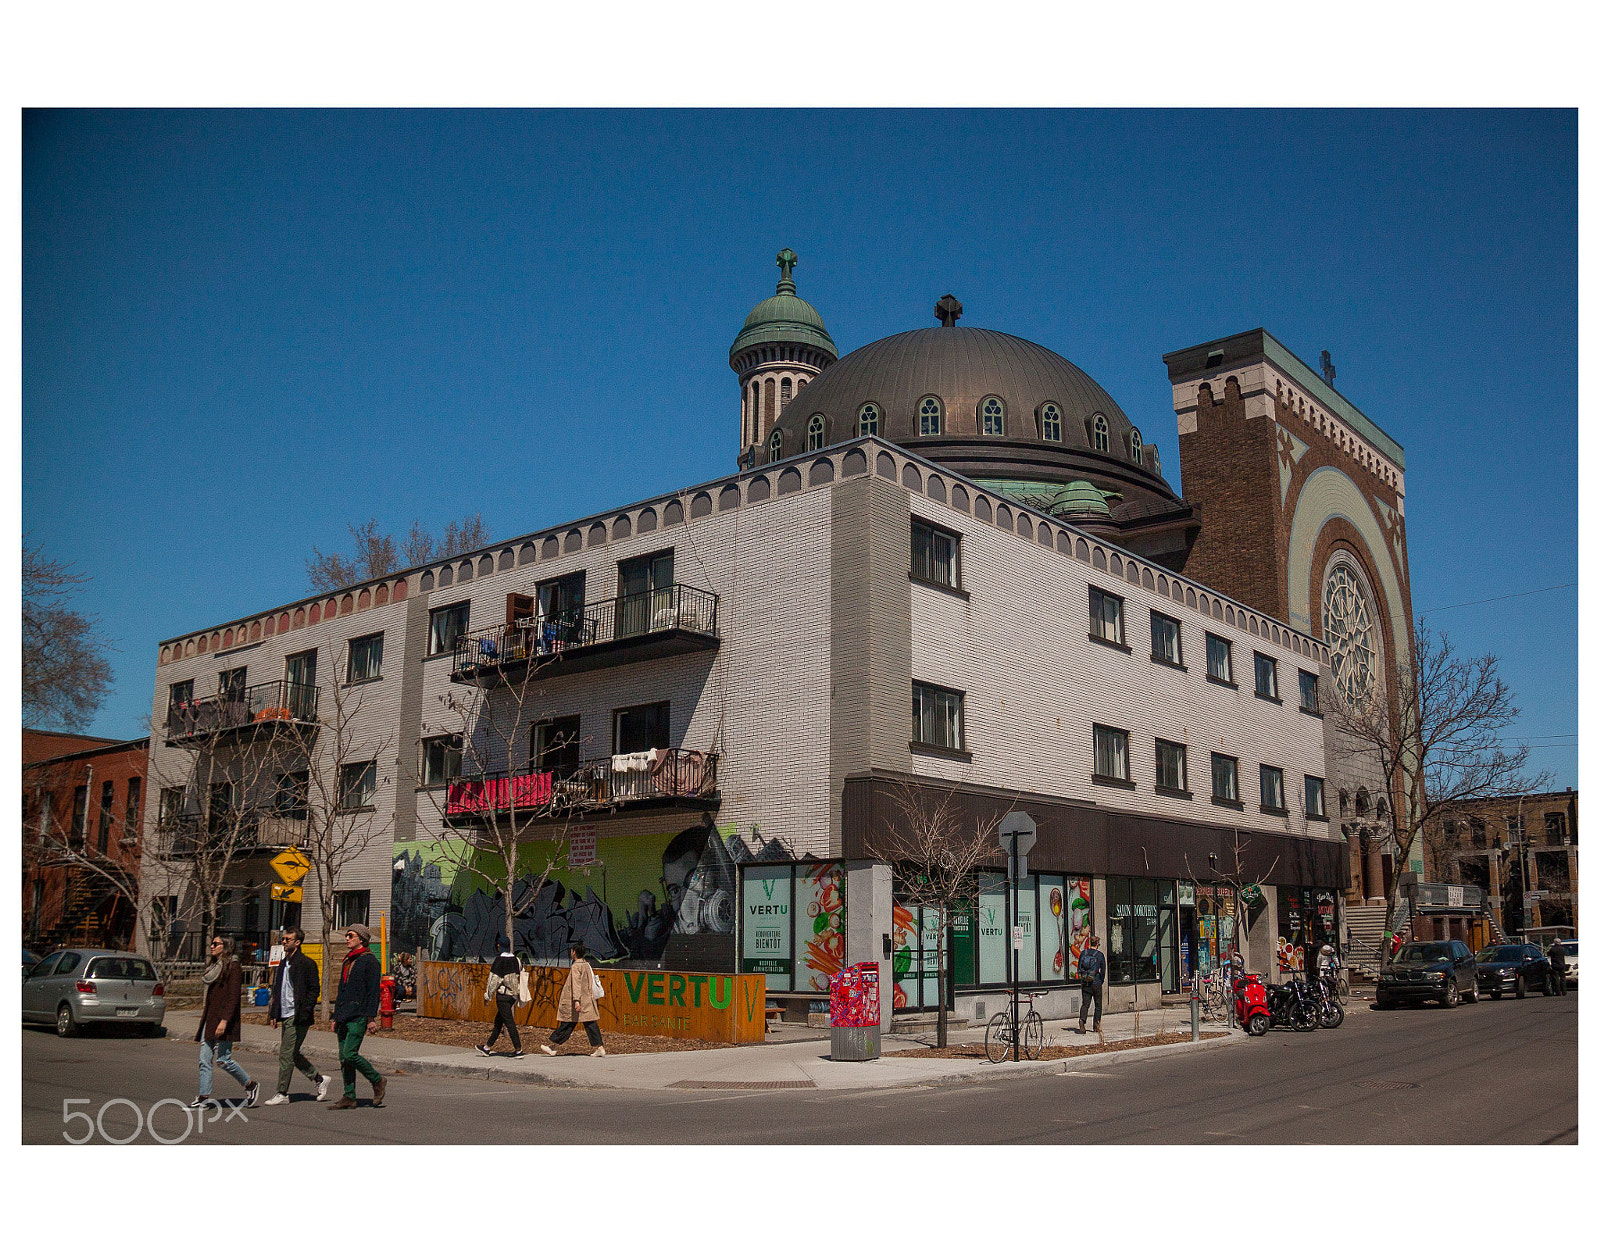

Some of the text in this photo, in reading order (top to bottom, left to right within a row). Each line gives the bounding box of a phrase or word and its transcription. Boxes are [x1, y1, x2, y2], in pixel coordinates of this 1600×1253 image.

[750, 905, 788, 915] VERTU
[981, 928, 1003, 936] VERTU
[623, 973, 733, 1010] VERTU
[623, 1014, 691, 1031] BAR SANTÉ
